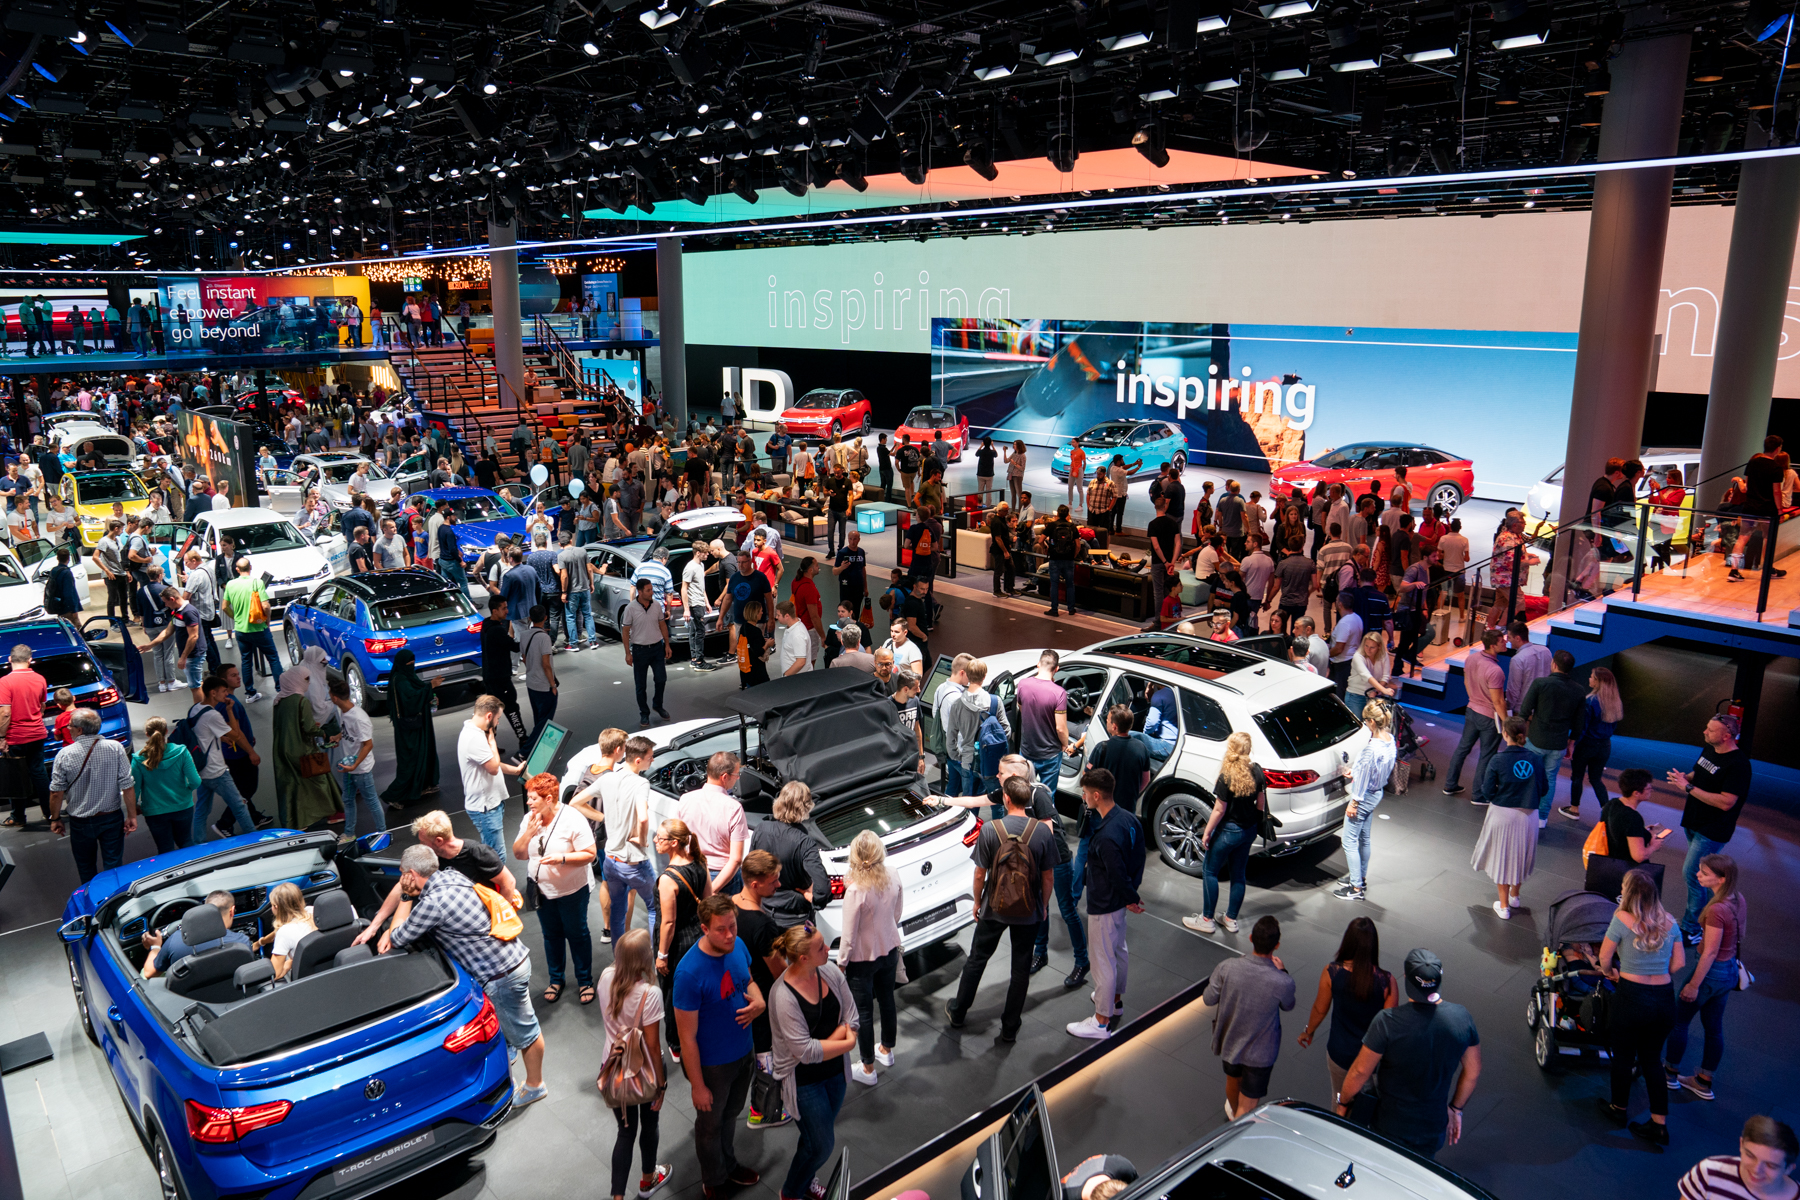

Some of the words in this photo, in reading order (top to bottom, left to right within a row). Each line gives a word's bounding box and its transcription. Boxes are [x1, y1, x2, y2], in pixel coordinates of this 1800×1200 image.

[167, 285, 201, 300] Feel
[206, 285, 256, 300] instant
[169, 308, 235, 322] e-power
[171, 327, 193, 343] go
[199, 324, 260, 341] beyond!
[1116, 359, 1316, 431] inspiring
[871, 517, 884, 529] We
[338, 1158, 372, 1176] T-ROC
[373, 1133, 429, 1162] CABRIOLET
